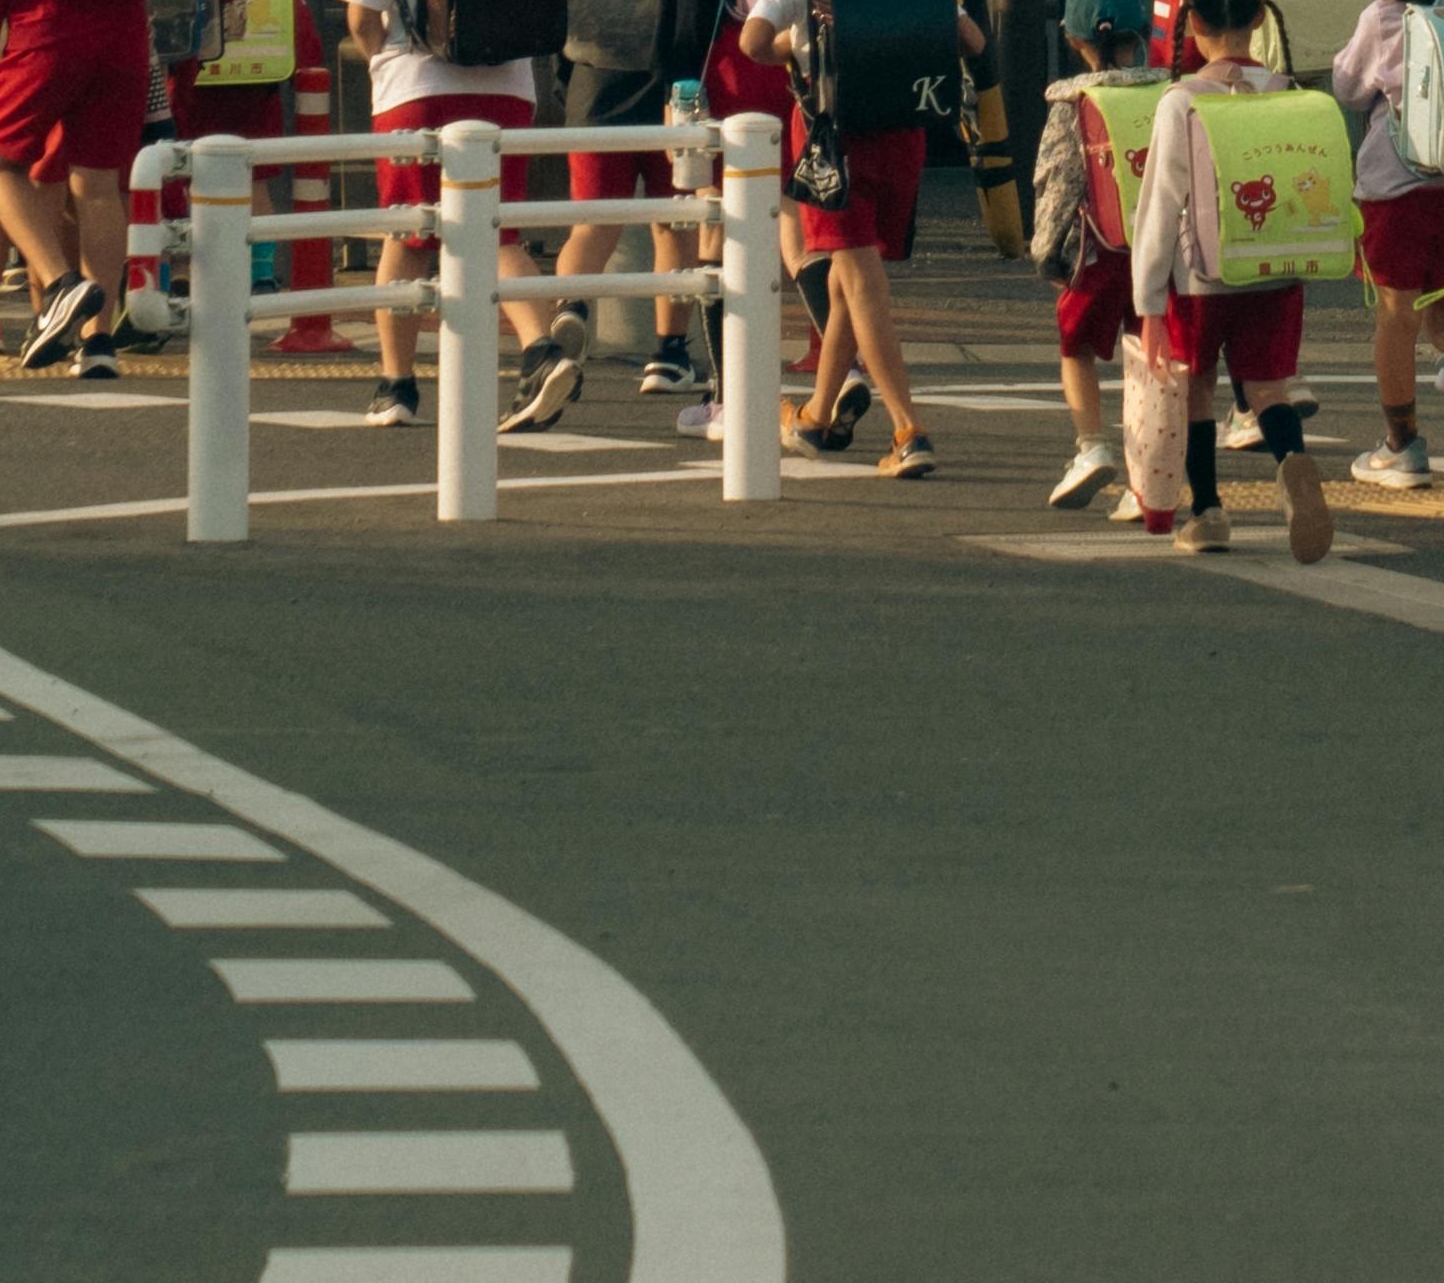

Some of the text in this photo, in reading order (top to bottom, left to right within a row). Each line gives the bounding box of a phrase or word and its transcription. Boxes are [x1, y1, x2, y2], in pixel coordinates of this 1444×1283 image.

[913, 75, 952, 116] K
[1243, 142, 1329, 162] こうつうあんぜん
